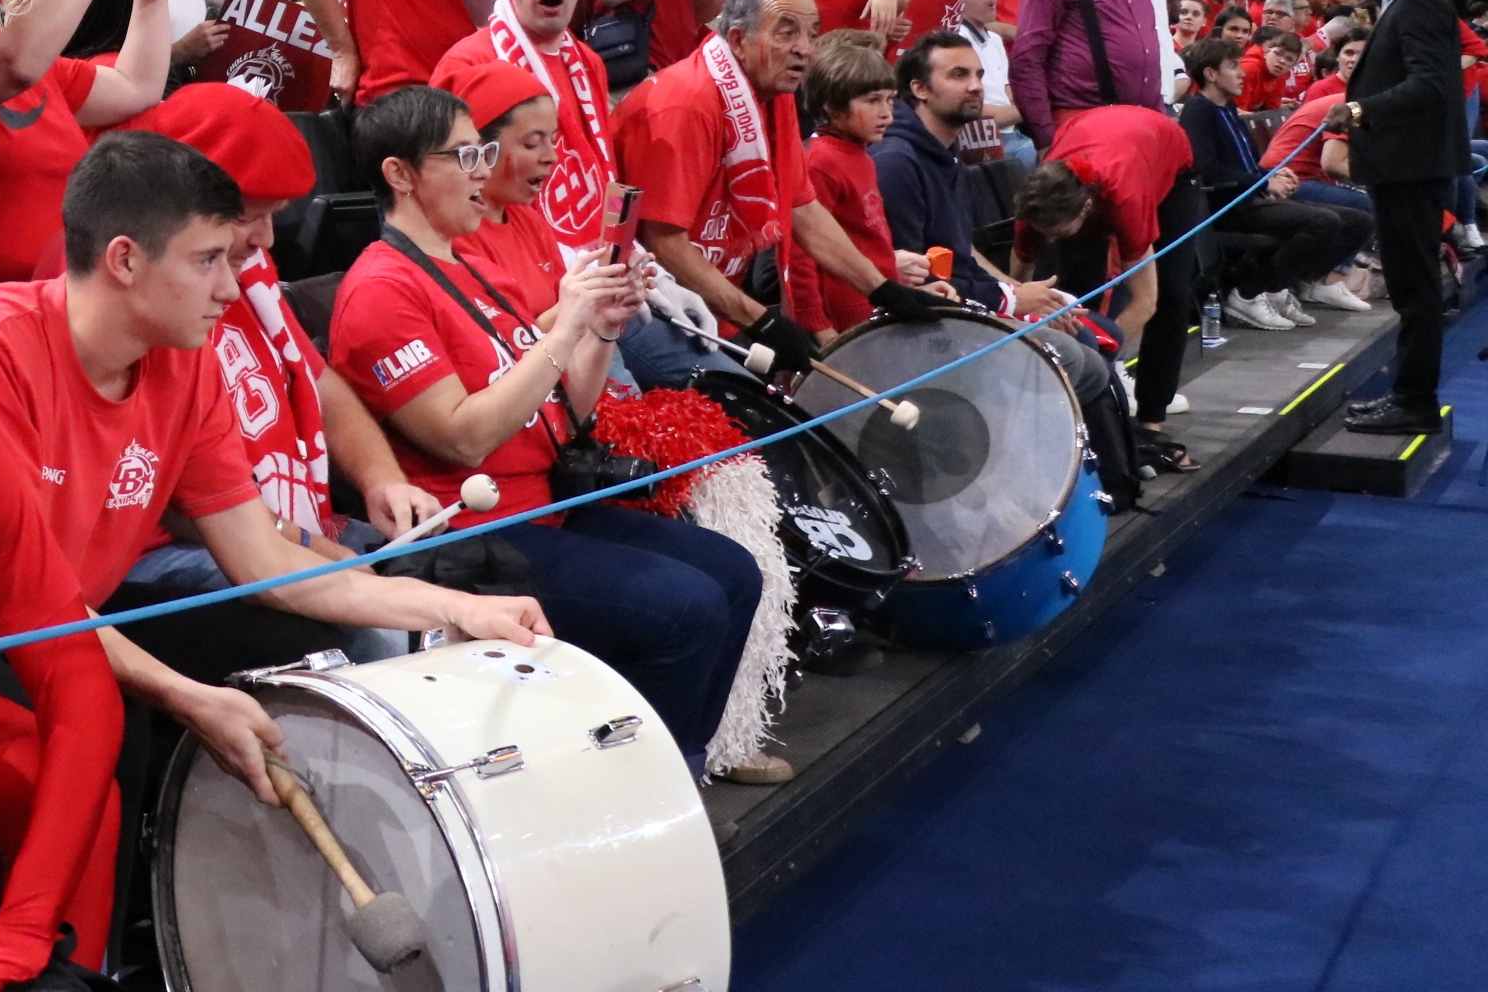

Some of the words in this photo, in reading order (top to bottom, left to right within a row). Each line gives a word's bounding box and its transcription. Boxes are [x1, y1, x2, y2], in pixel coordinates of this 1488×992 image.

[709, 44, 741, 90] BASKET
[730, 91, 758, 144] CHOLET
[958, 118, 1001, 152] ALLEZ
[383, 338, 433, 380] LNB
